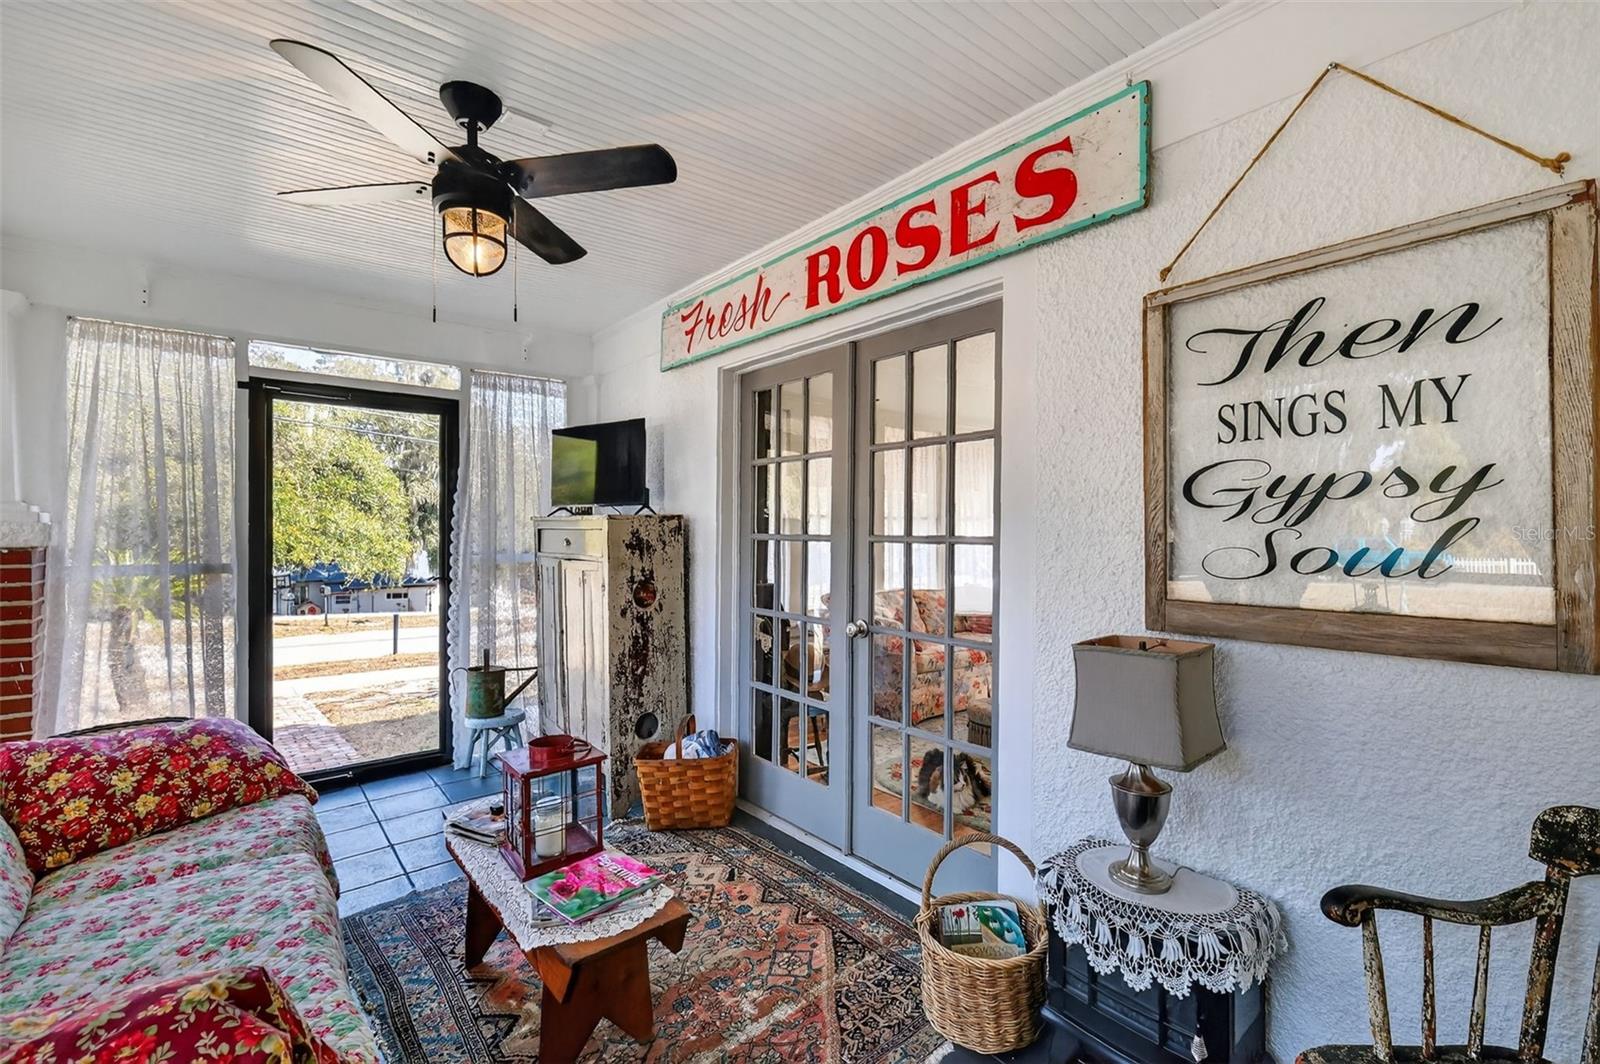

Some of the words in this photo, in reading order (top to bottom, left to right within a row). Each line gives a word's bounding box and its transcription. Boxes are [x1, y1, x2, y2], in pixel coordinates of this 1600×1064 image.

[681, 274, 790, 354] Fresh
[804, 136, 1079, 310] ROSES
[1186, 297, 1503, 386] Then
[1217, 389, 1348, 444] SINGS
[1378, 373, 1472, 430] MY
[1182, 458, 1505, 527] Gypsy
[1201, 517, 1481, 580] Soul
